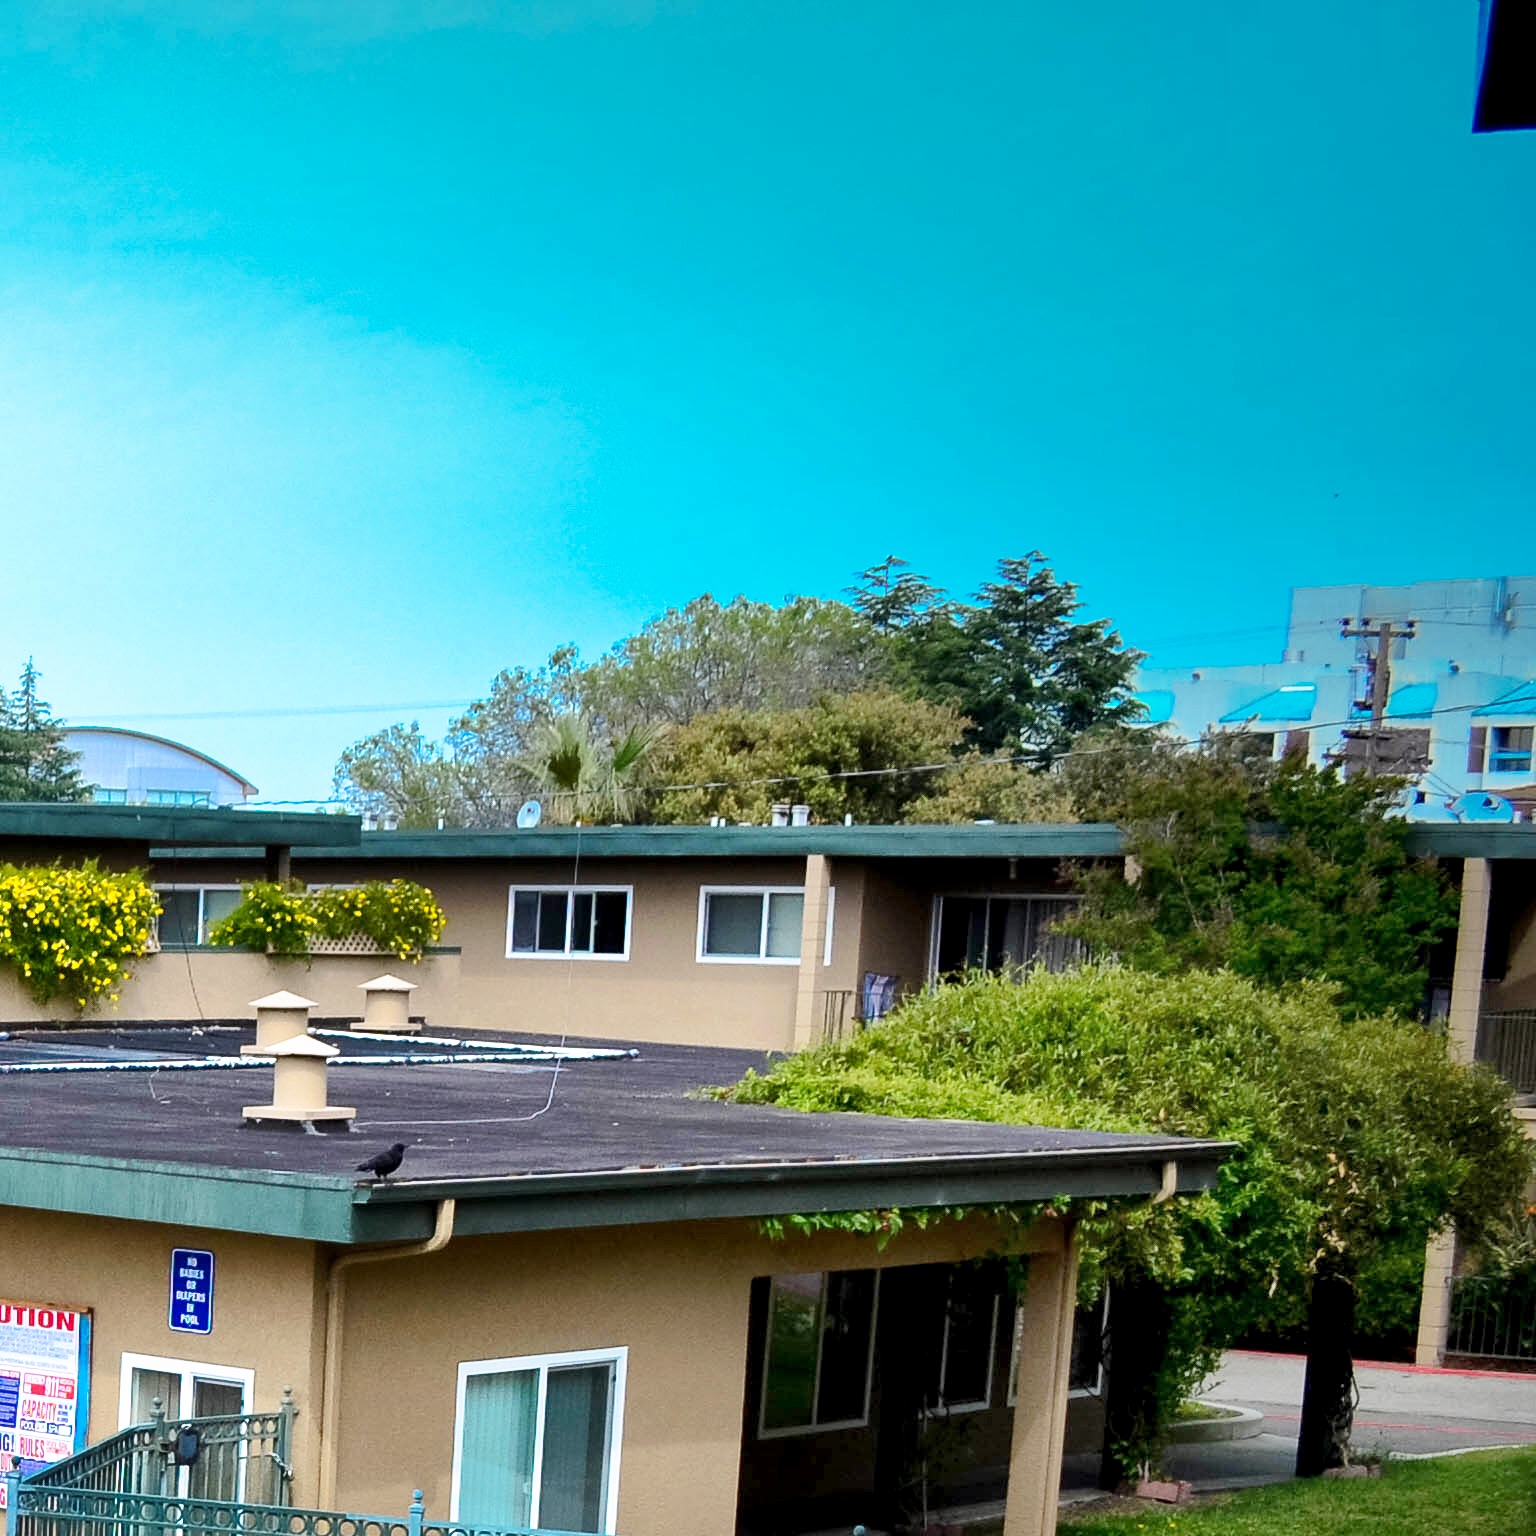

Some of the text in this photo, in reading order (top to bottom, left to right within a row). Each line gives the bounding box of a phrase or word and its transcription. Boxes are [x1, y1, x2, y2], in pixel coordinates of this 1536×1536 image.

[180, 1313, 199, 1325] POOL
[22, 1399, 56, 1421] CAPACITY
[20, 1437, 45, 1458] RULES
